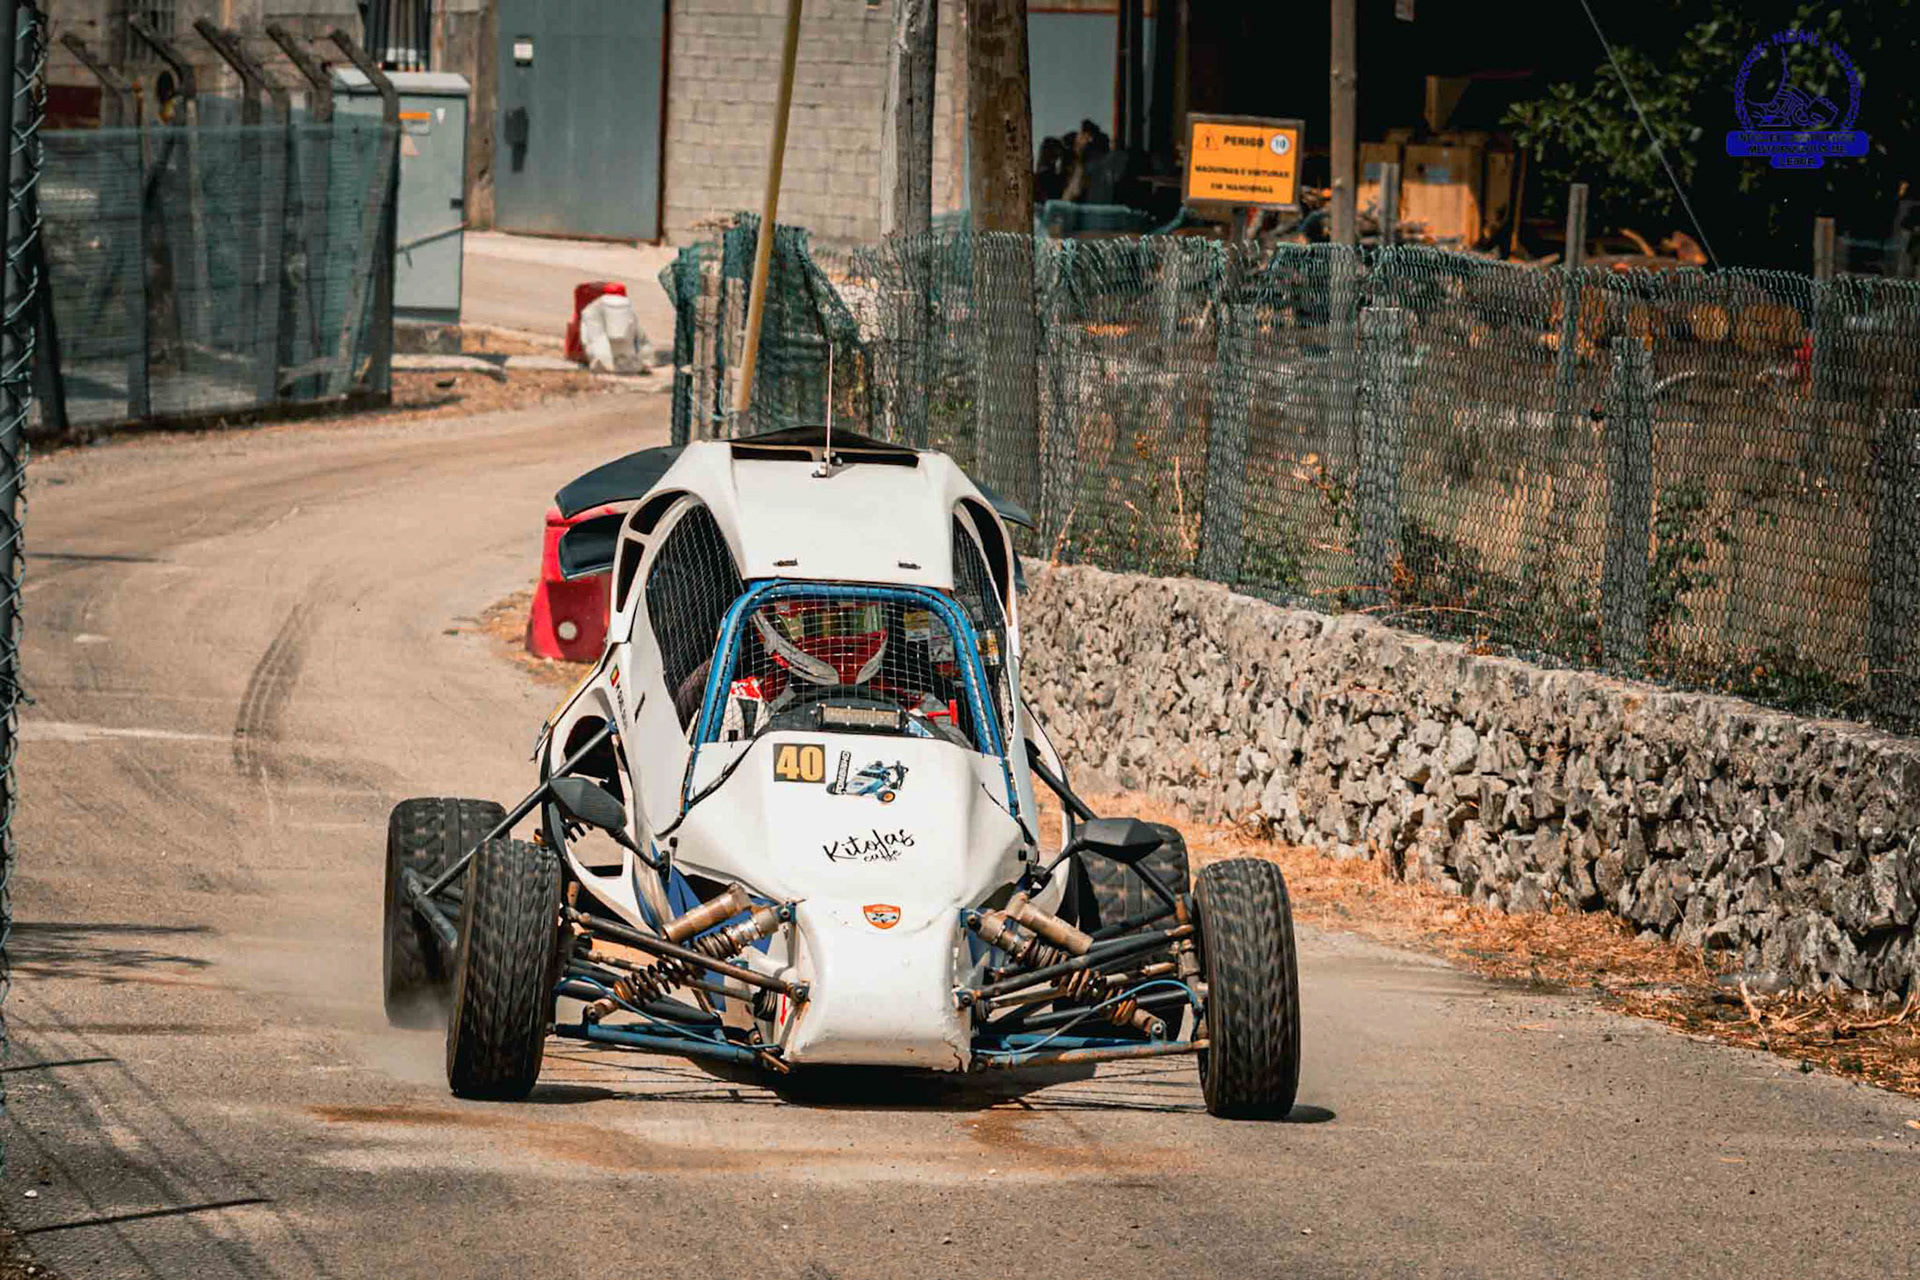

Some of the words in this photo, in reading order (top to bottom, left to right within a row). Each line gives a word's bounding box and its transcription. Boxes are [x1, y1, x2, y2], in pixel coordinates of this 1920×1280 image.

[1223, 135, 1265, 148] PERIGO
[1275, 139, 1286, 149] 10
[776, 745, 824, 782] 40
